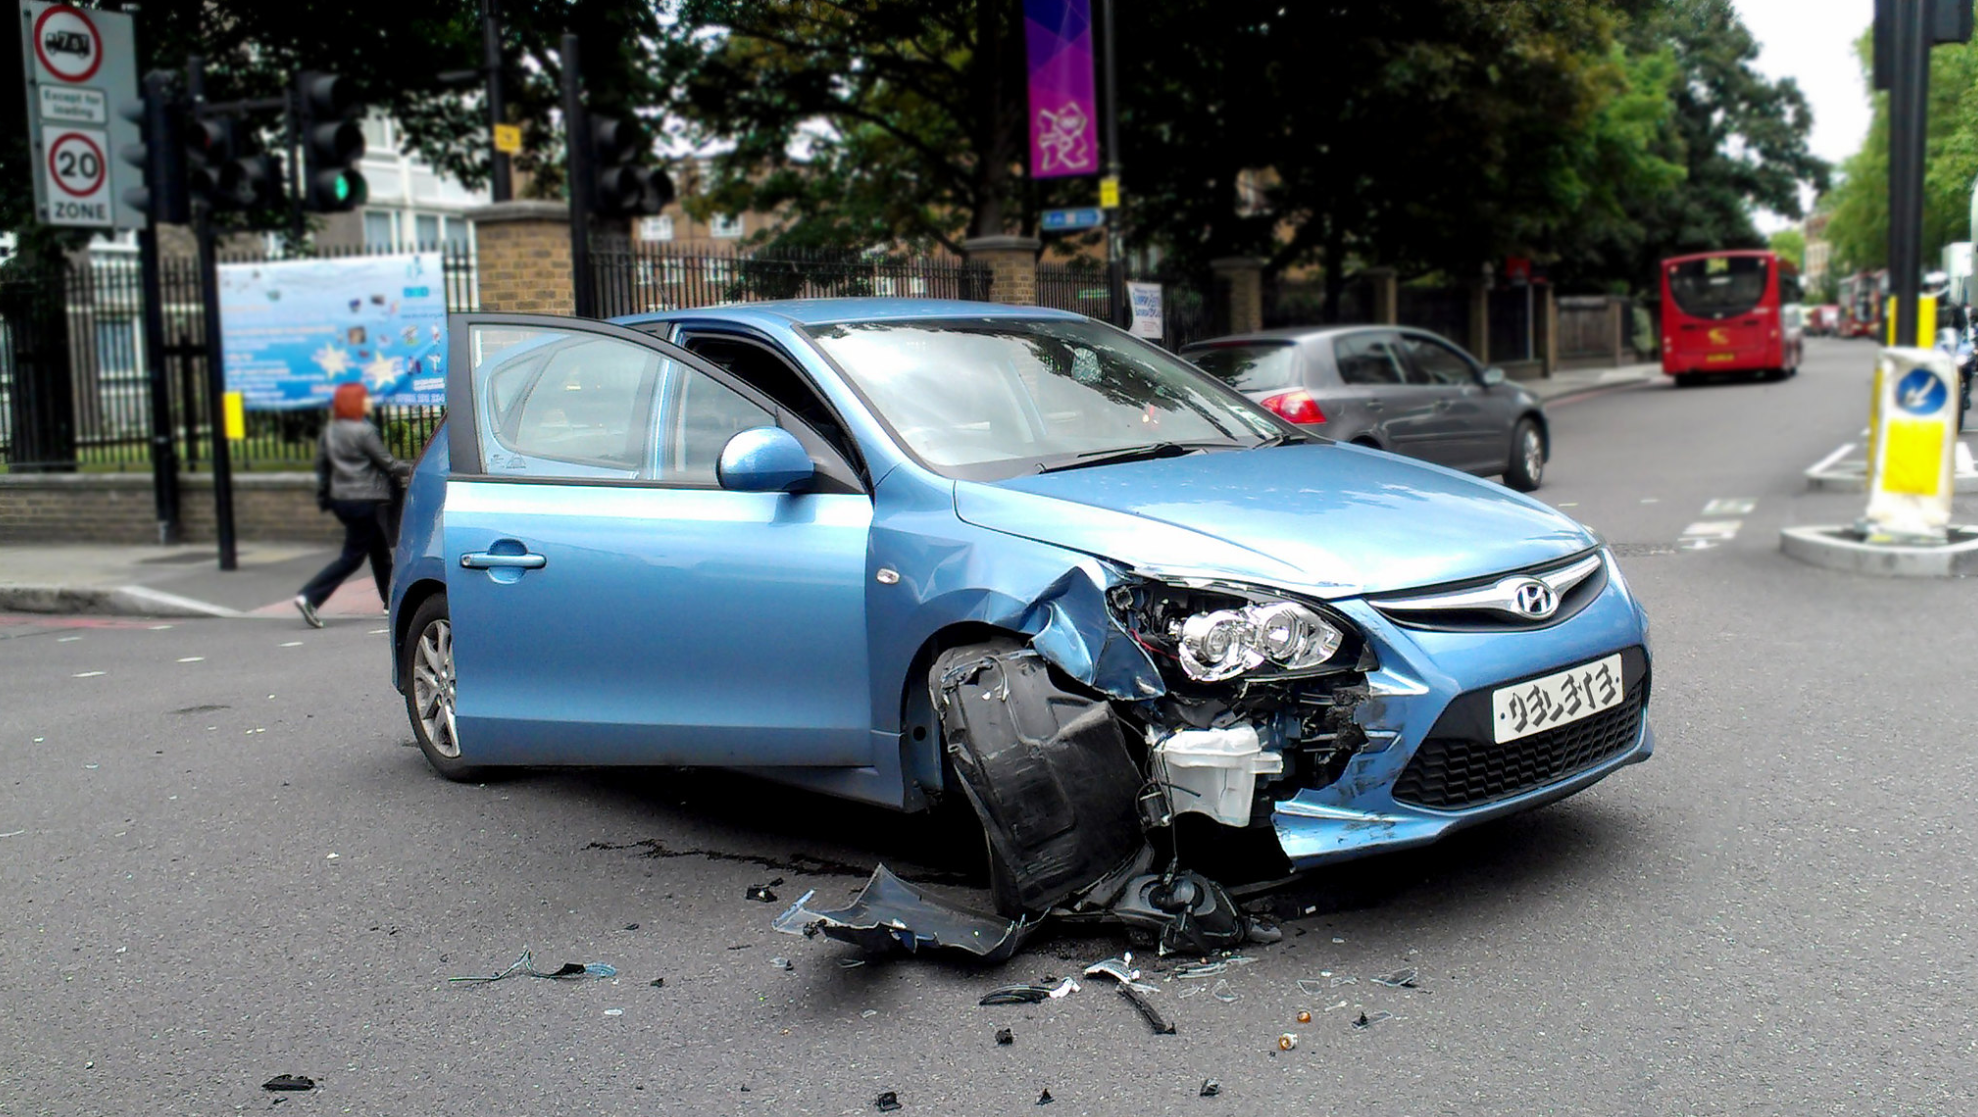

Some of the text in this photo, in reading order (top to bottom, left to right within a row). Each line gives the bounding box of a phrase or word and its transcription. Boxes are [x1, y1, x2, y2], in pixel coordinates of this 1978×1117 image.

[44, 89, 81, 104] Except
[53, 104, 94, 119] loading
[59, 150, 98, 179] 20
[54, 201, 106, 220] ZONE
